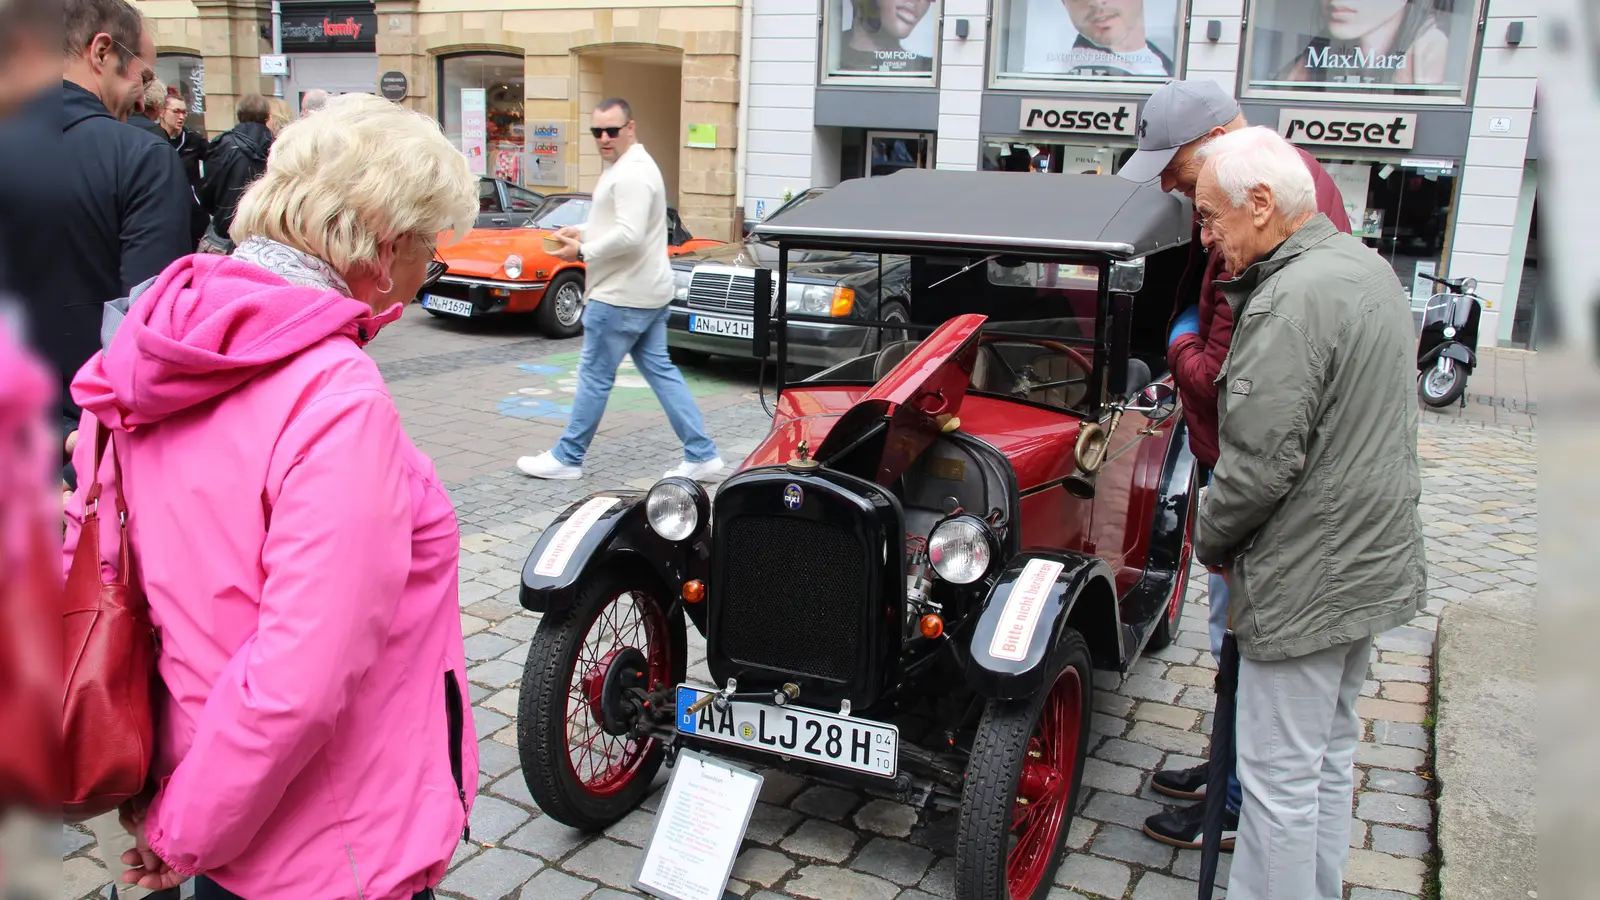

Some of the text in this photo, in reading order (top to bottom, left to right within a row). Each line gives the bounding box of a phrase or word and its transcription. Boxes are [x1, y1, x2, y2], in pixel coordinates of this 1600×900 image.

[323, 16, 361, 39] family
[874, 51, 916, 60] TOM FORD
[1305, 46, 1406, 69] MaxMara
[1026, 106, 1129, 131] rosset
[1285, 117, 1407, 144] rosset
[1002, 563, 1053, 653] Bitte nicht berühren
